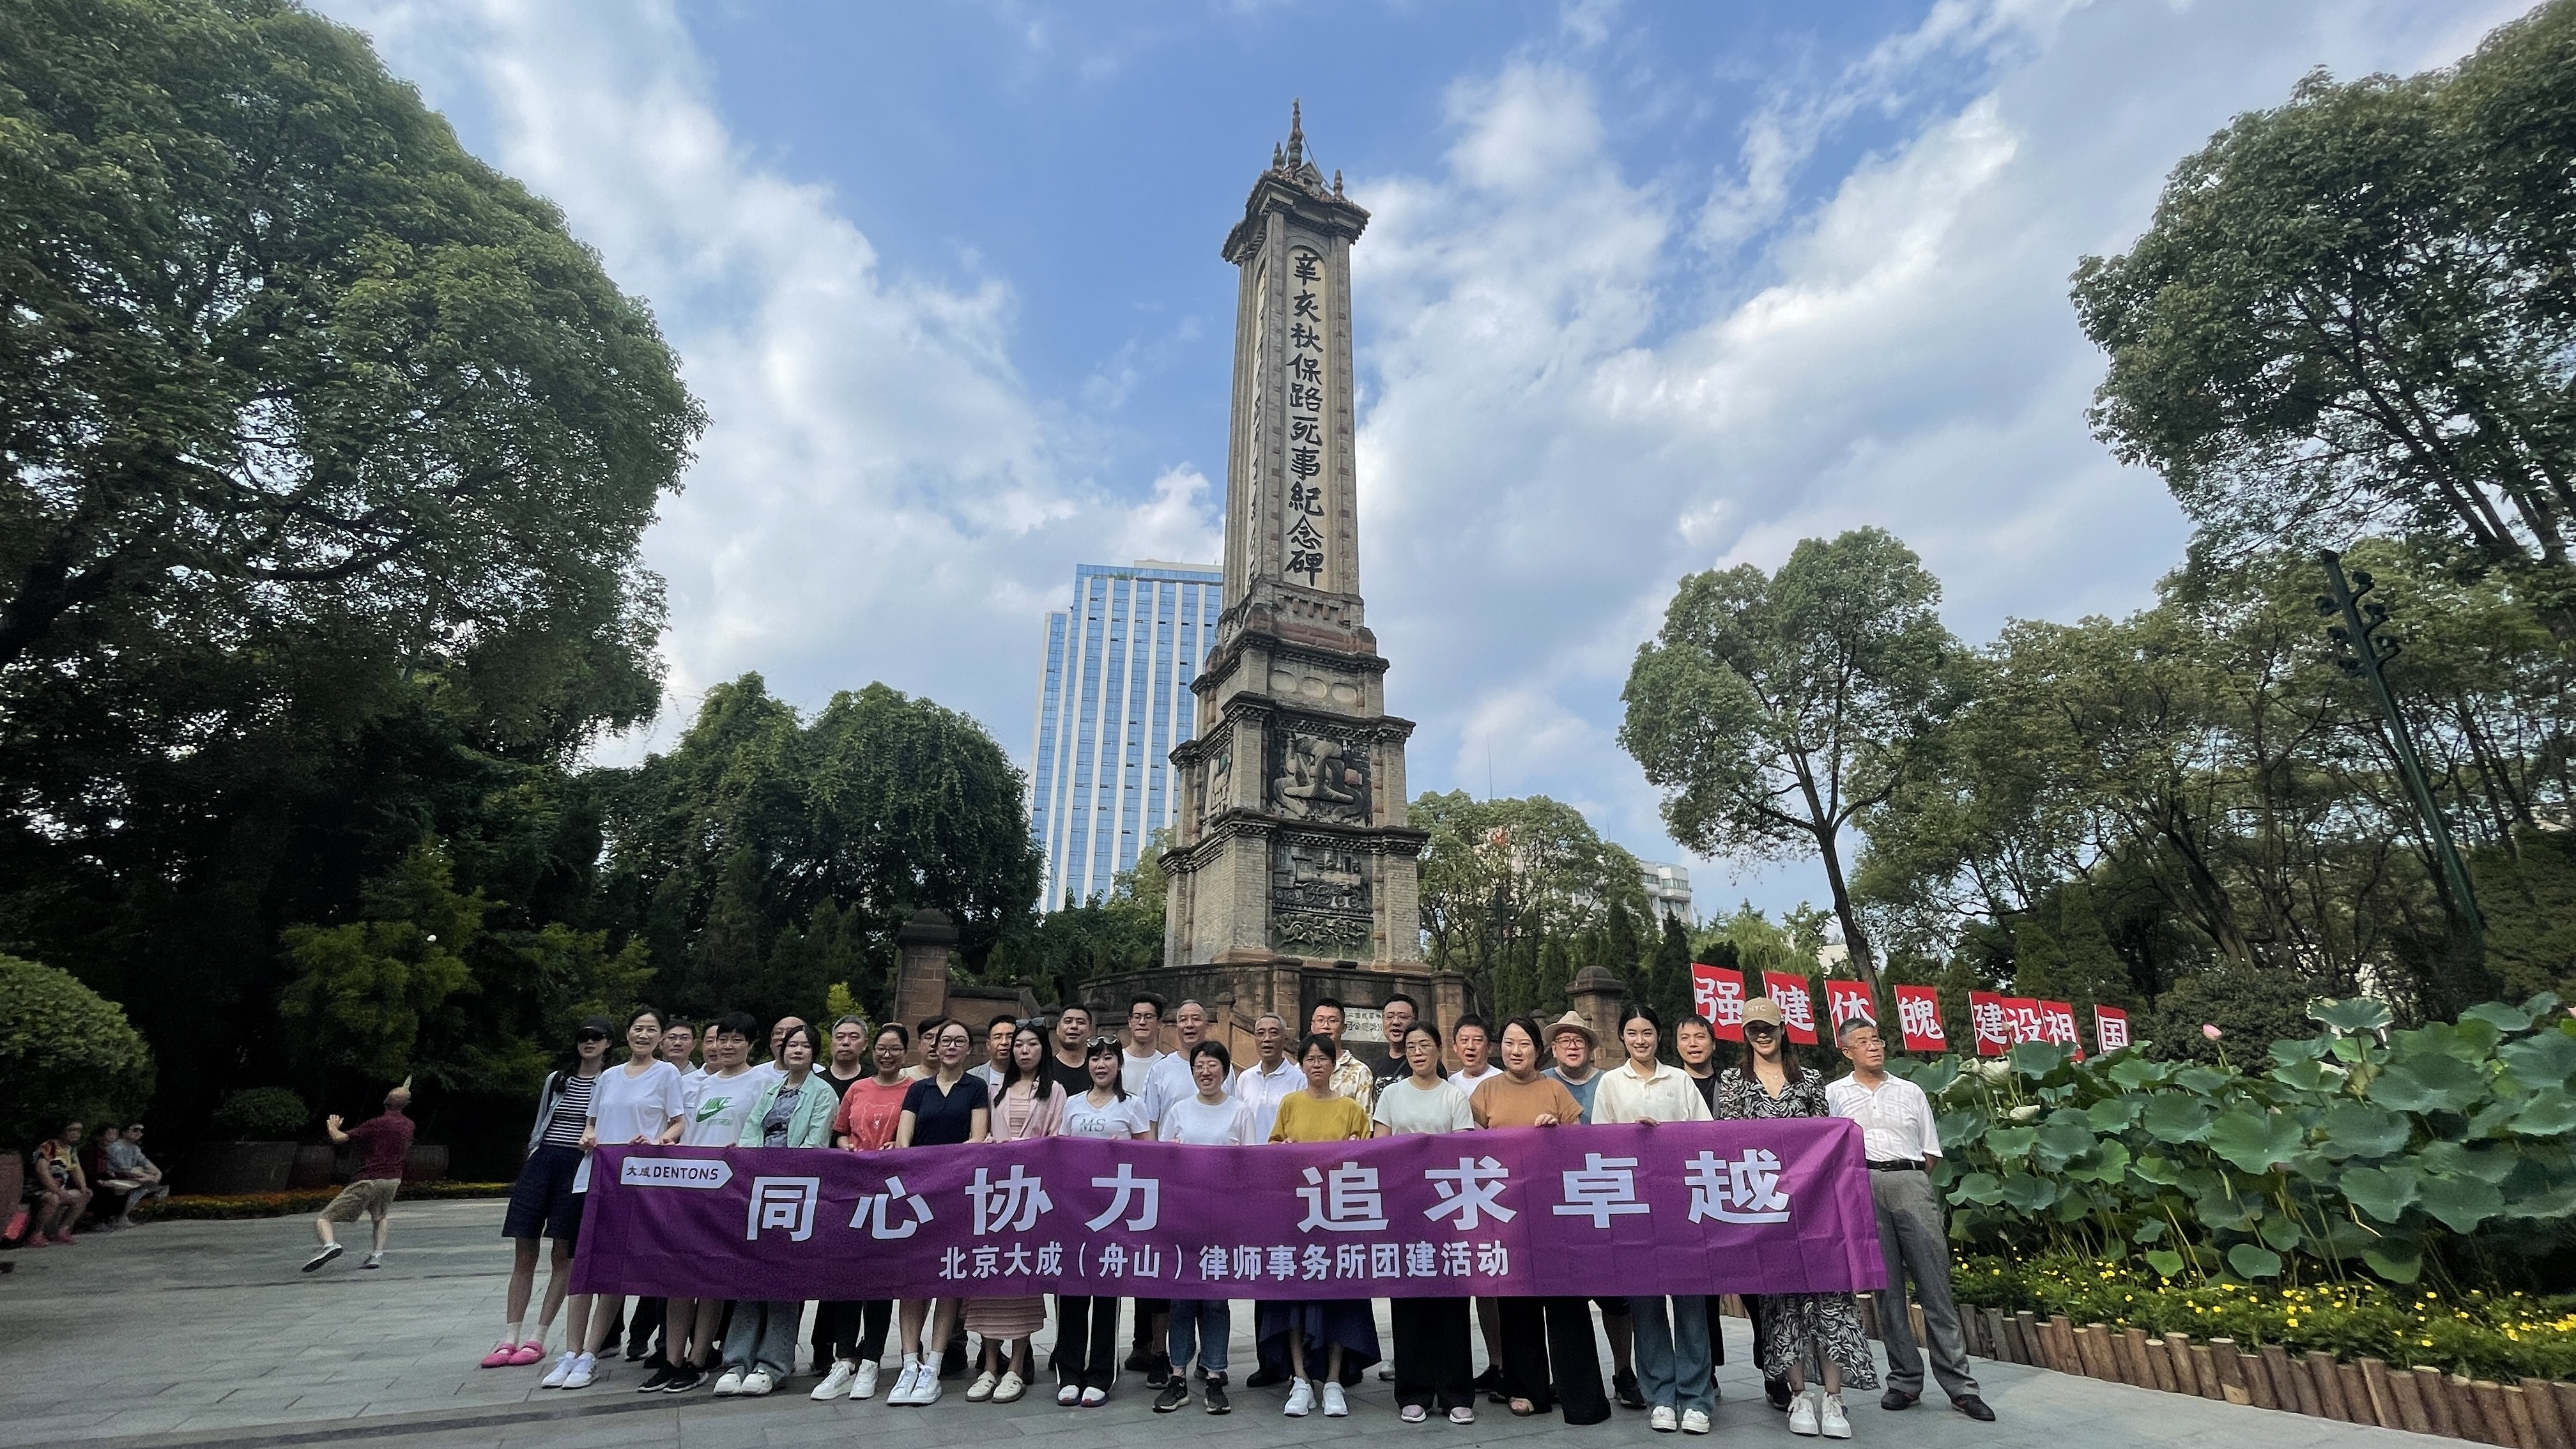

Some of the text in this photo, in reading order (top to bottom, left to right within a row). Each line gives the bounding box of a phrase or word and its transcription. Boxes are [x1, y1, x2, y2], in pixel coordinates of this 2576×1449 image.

[1285, 252, 1324, 587] 辛亥秋保路死事紀念碑
[1973, 1002, 2129, 1050] 建设祖国
[1080, 1118, 1106, 1131] MS
[653, 1166, 719, 1180] DENTONS
[746, 1149, 1791, 1242] 同心协力 追求卓越
